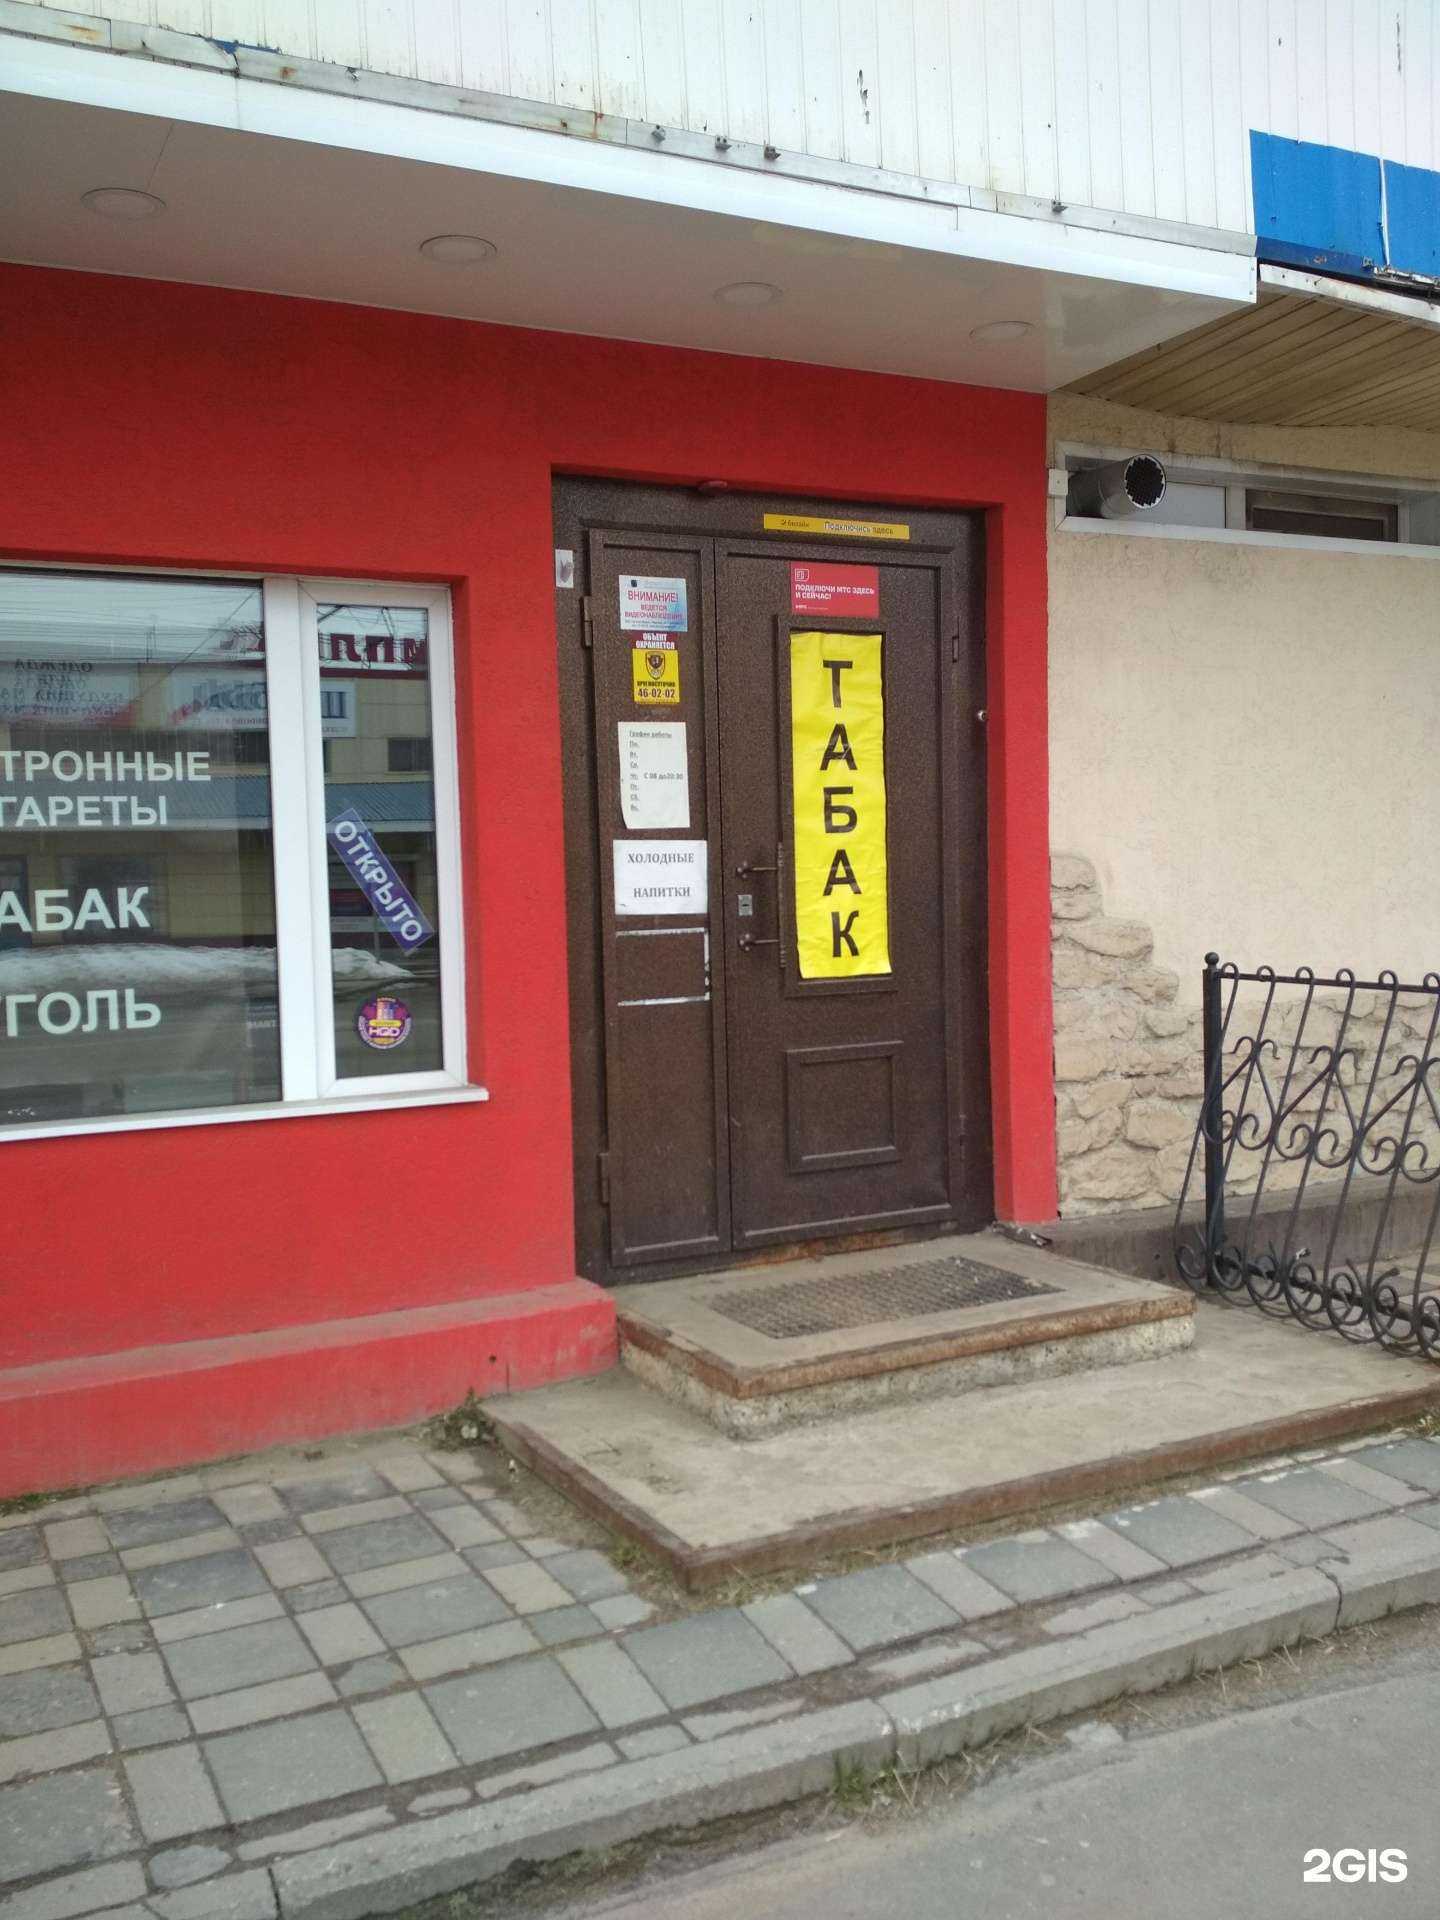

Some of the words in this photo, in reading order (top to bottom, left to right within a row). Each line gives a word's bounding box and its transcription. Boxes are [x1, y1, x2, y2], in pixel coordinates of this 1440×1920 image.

[824, 521, 871, 533] Подключись
[872, 526, 894, 535] здесь
[795, 584, 836, 594] ПОДКЛЮЧИ
[837, 586, 852, 594] МТС
[852, 587, 875, 595] ЗДЕСЬ
[802, 592, 832, 600] СЕЙЧАС!
[627, 590, 679, 603] ВНИМАНИЕ!
[642, 633, 667, 642] ОБЪЕКТ
[637, 688, 675, 699] 46-02-02
[1, 750, 212, 782] ТРОННЫЕ
[820, 659, 862, 958] ТАБАК
[627, 852, 695, 865] ХОЛОДНЫЕ
[333, 820, 423, 942] ОТКРЫТО
[633, 886, 691, 899] НАПИТКИ
[0, 886, 151, 933] АБАК
[0, 988, 162, 1038] ГОЛЬ
